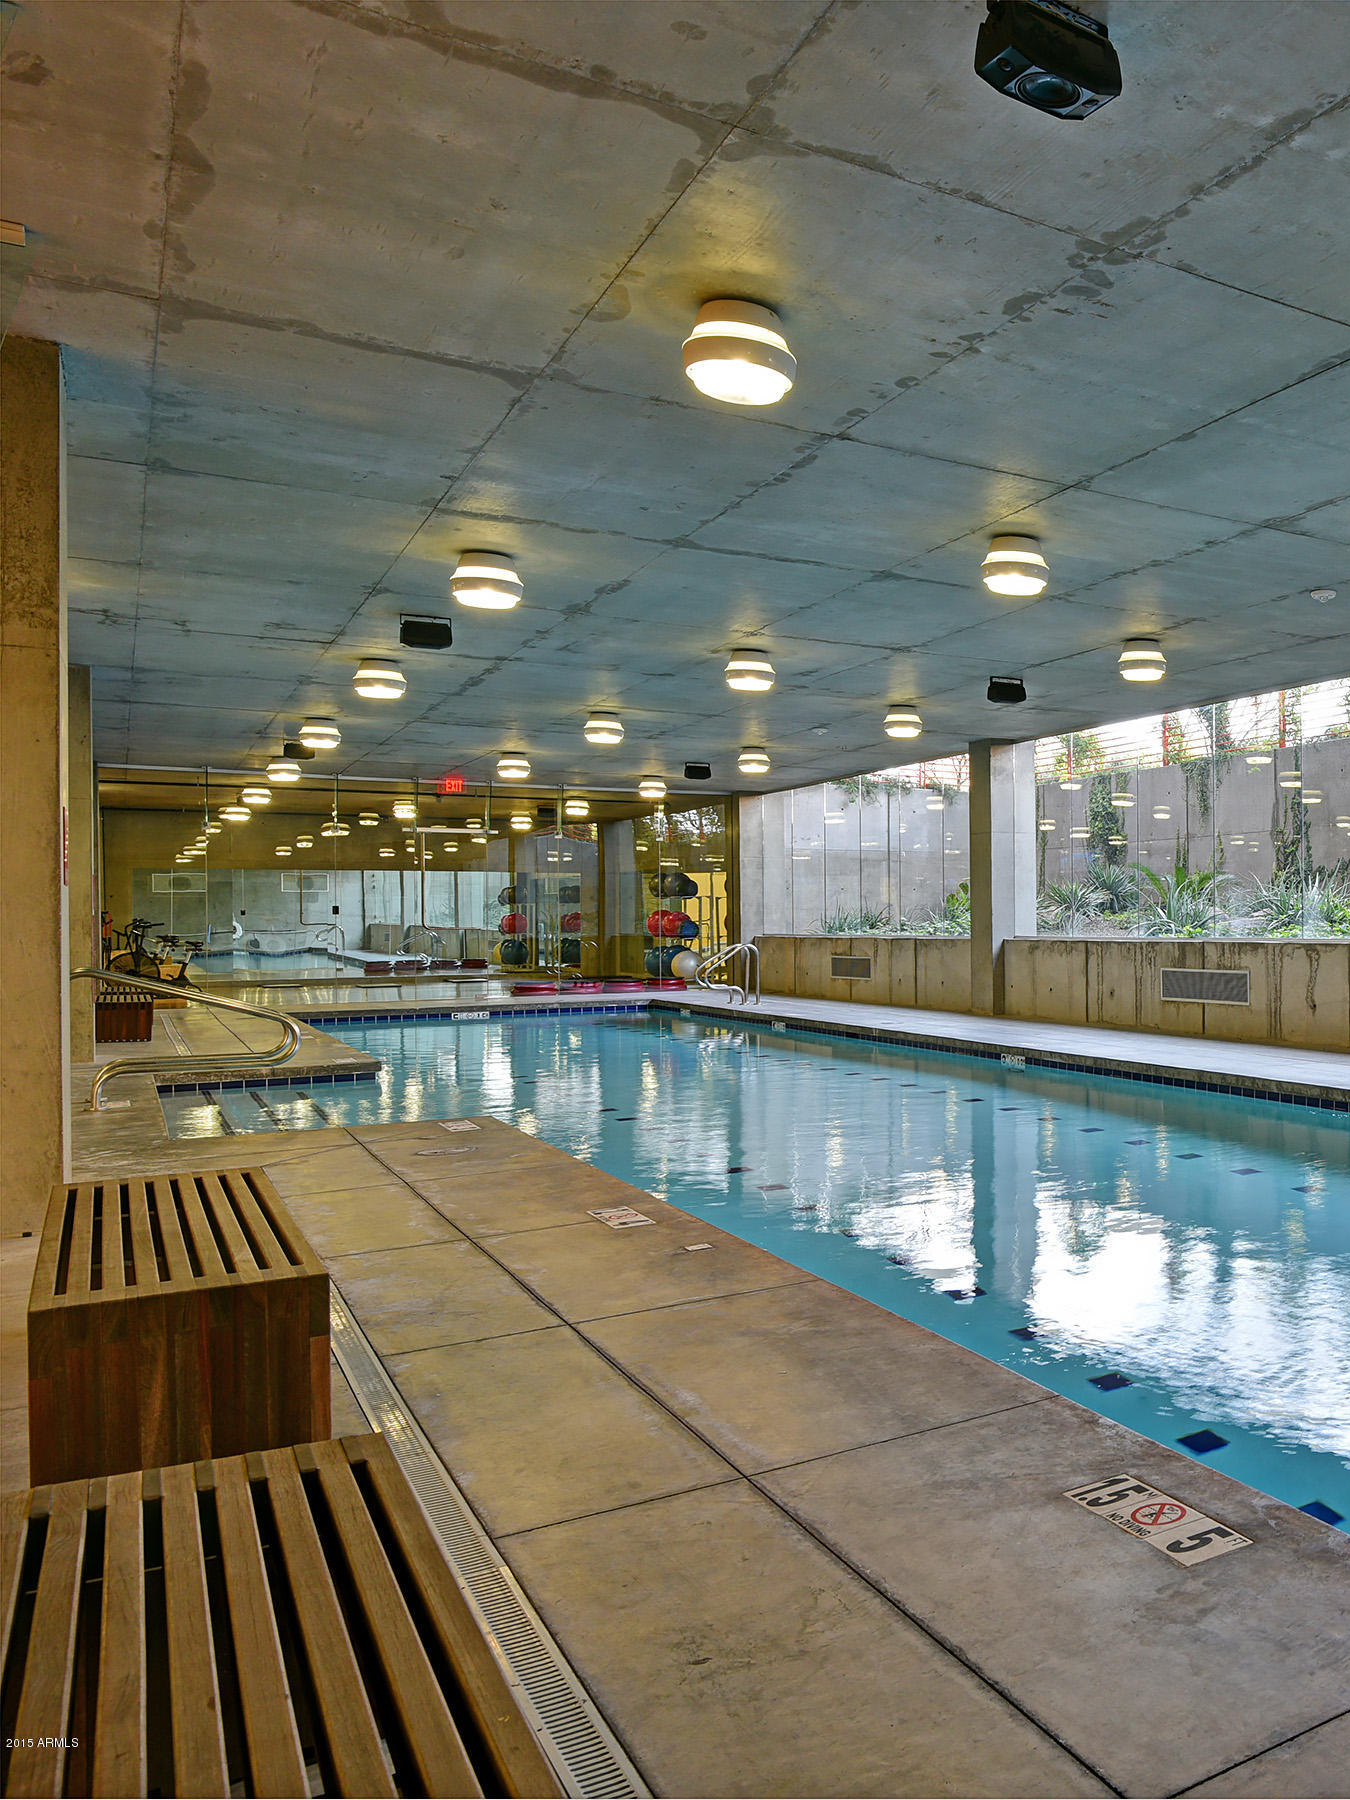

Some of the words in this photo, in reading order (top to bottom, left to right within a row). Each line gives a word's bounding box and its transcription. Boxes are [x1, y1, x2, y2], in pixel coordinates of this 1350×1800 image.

[446, 780, 463, 792] EXIT
[1105, 1512, 1124, 1521] NO
[1118, 1519, 1151, 1537] DIVING
